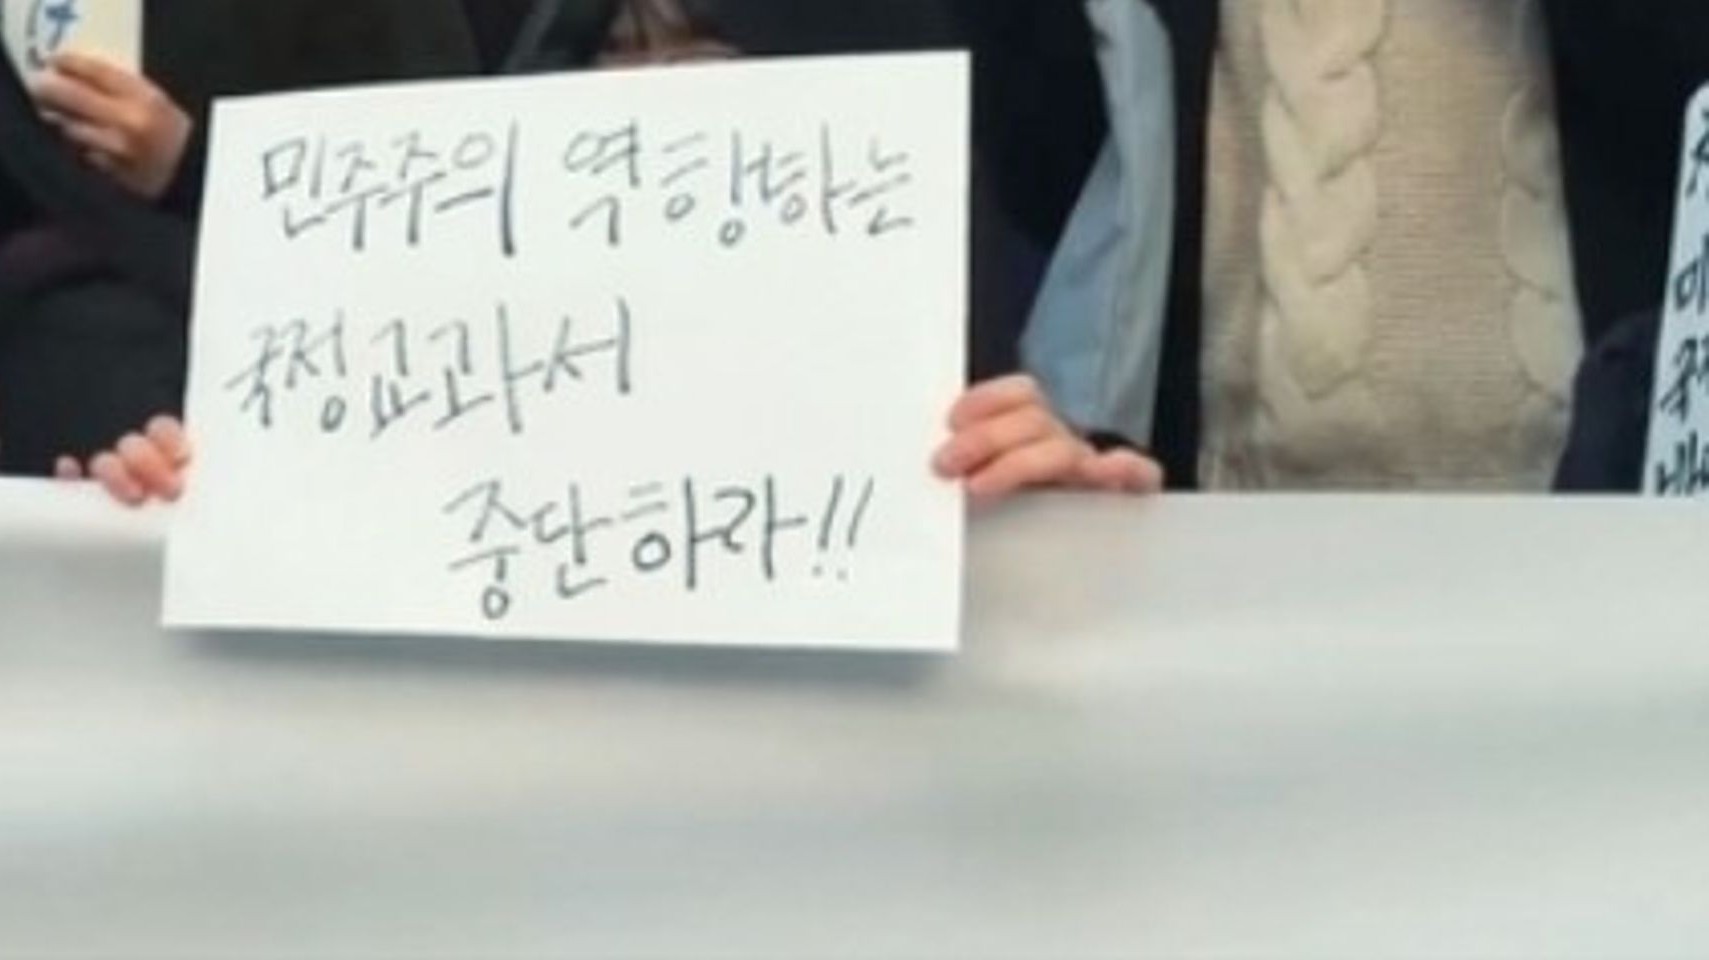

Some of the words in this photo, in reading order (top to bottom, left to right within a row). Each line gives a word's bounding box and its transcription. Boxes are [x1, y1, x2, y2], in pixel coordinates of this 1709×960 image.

[259, 120, 518, 259] 민주주의
[224, 294, 634, 440] 국정교과서
[441, 472, 877, 622] 중단하라!!
